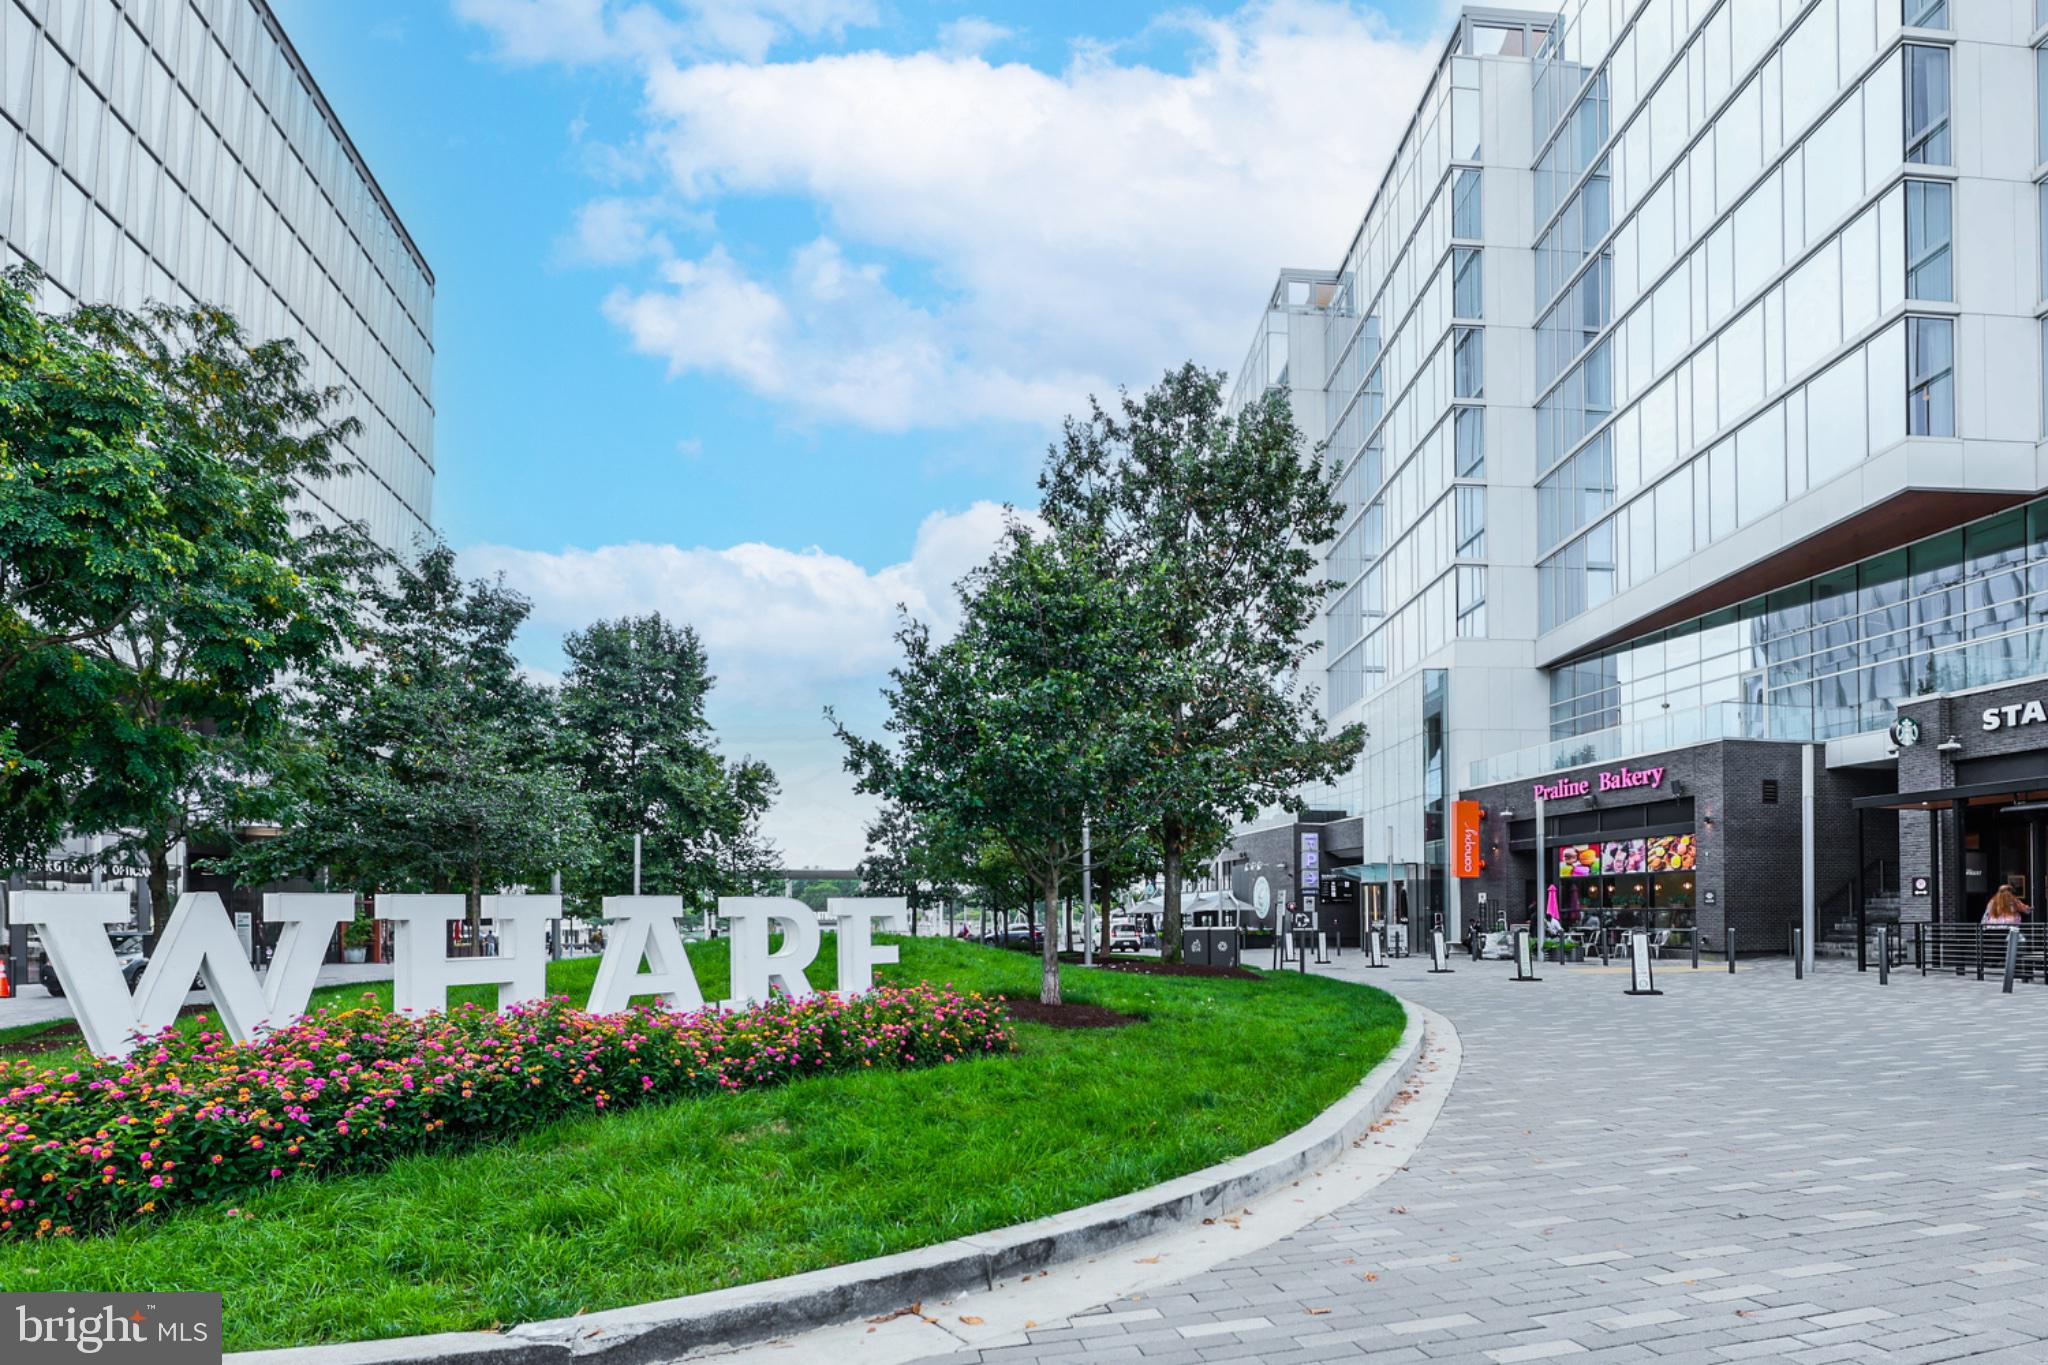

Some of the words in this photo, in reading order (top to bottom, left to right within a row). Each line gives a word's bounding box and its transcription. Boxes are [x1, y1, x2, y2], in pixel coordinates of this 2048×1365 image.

[1982, 700, 2047, 731] STA
[1533, 778, 1590, 801] Praline
[1599, 767, 1665, 791] Bakery
[1464, 820, 1478, 873] canopy
[9, 890, 908, 1062] WHARF
